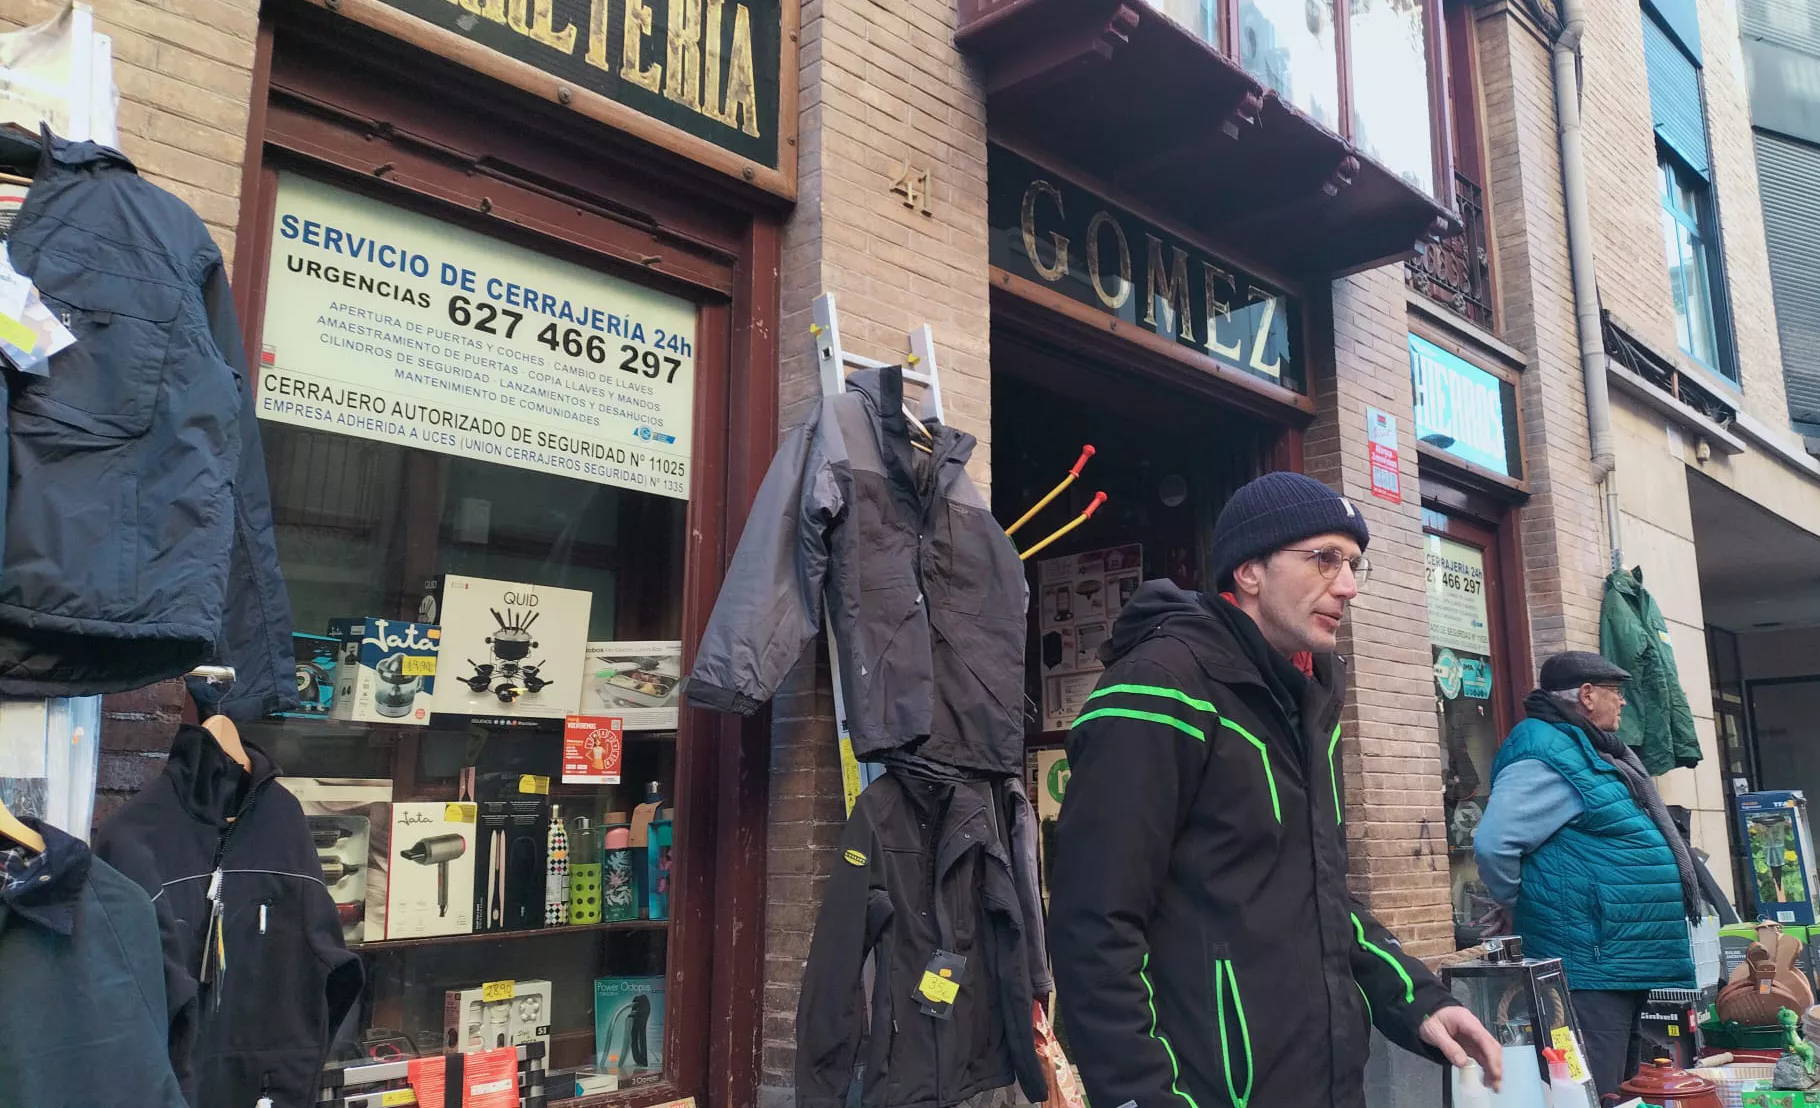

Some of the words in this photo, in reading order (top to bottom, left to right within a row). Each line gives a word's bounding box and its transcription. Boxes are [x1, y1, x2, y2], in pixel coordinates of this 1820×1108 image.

[889, 156, 931, 216] 41
[280, 214, 429, 277] SERVICIO
[441, 262, 476, 293] DE
[487, 278, 645, 344] CERRAJERÍA
[654, 329, 692, 357] 24h
[1020, 179, 1280, 377] GOMEZ
[287, 255, 430, 308] URGENCIAS
[448, 295, 523, 339] 627
[538, 322, 605, 363] 466
[619, 345, 681, 383] 297
[329, 302, 402, 328] APERTURA
[406, 322, 422, 333] DE
[427, 327, 482, 350] PUERTAS
[487, 343, 493, 352] Y
[497, 346, 544, 366] COCHES
[554, 362, 596, 380] CAMBIO
[600, 374, 612, 384] DE
[616, 379, 654, 395] LLAVES
[317, 316, 440, 355] AMAESTRAMIENTO
[444, 348, 460, 360] DE
[465, 353, 518, 374] PUERTAS
[529, 370, 561, 386] COPIA
[566, 380, 604, 398] LLAVES
[608, 390, 615, 399] Y
[618, 394, 660, 411] MANDOS
[320, 334, 392, 359] CILINDROS
[397, 353, 413, 365] DE
[418, 359, 489, 383] SEGURIDAD
[500, 379, 585, 407] LANZAMIENTOS
[589, 400, 595, 409] Y
[598, 404, 664, 427] DESAHUCIOS
[394, 369, 497, 400] MANTENIMIENTO
[501, 395, 515, 405] DE
[520, 400, 600, 426] COMUNIDADES
[264, 374, 385, 413] CERRAJERO
[392, 401, 505, 438] AUTORIZADO
[512, 426, 532, 444] DE
[537, 432, 625, 464] SEGURIDAD
[630, 453, 645, 467] Nº
[649, 457, 685, 477] 11025
[264, 398, 332, 422] EMPRESA
[337, 413, 405, 437] ADHERIDA
[409, 428, 417, 438] A
[423, 431, 456, 446] UCES
[460, 437, 502, 456] (UNION
[506, 447, 580, 471] CERRAJEROS
[584, 462, 647, 486] SEGURIDAD)
[663, 479, 683, 493] 1335
[503, 592, 539, 607] QUID
[1442, 572, 1460, 590] 466
[1464, 578, 1480, 595] 297
[1471, 567, 1482, 579] 24h
[362, 619, 440, 653] Jata
[398, 811, 434, 826] Jata
[598, 982, 619, 991] Power
